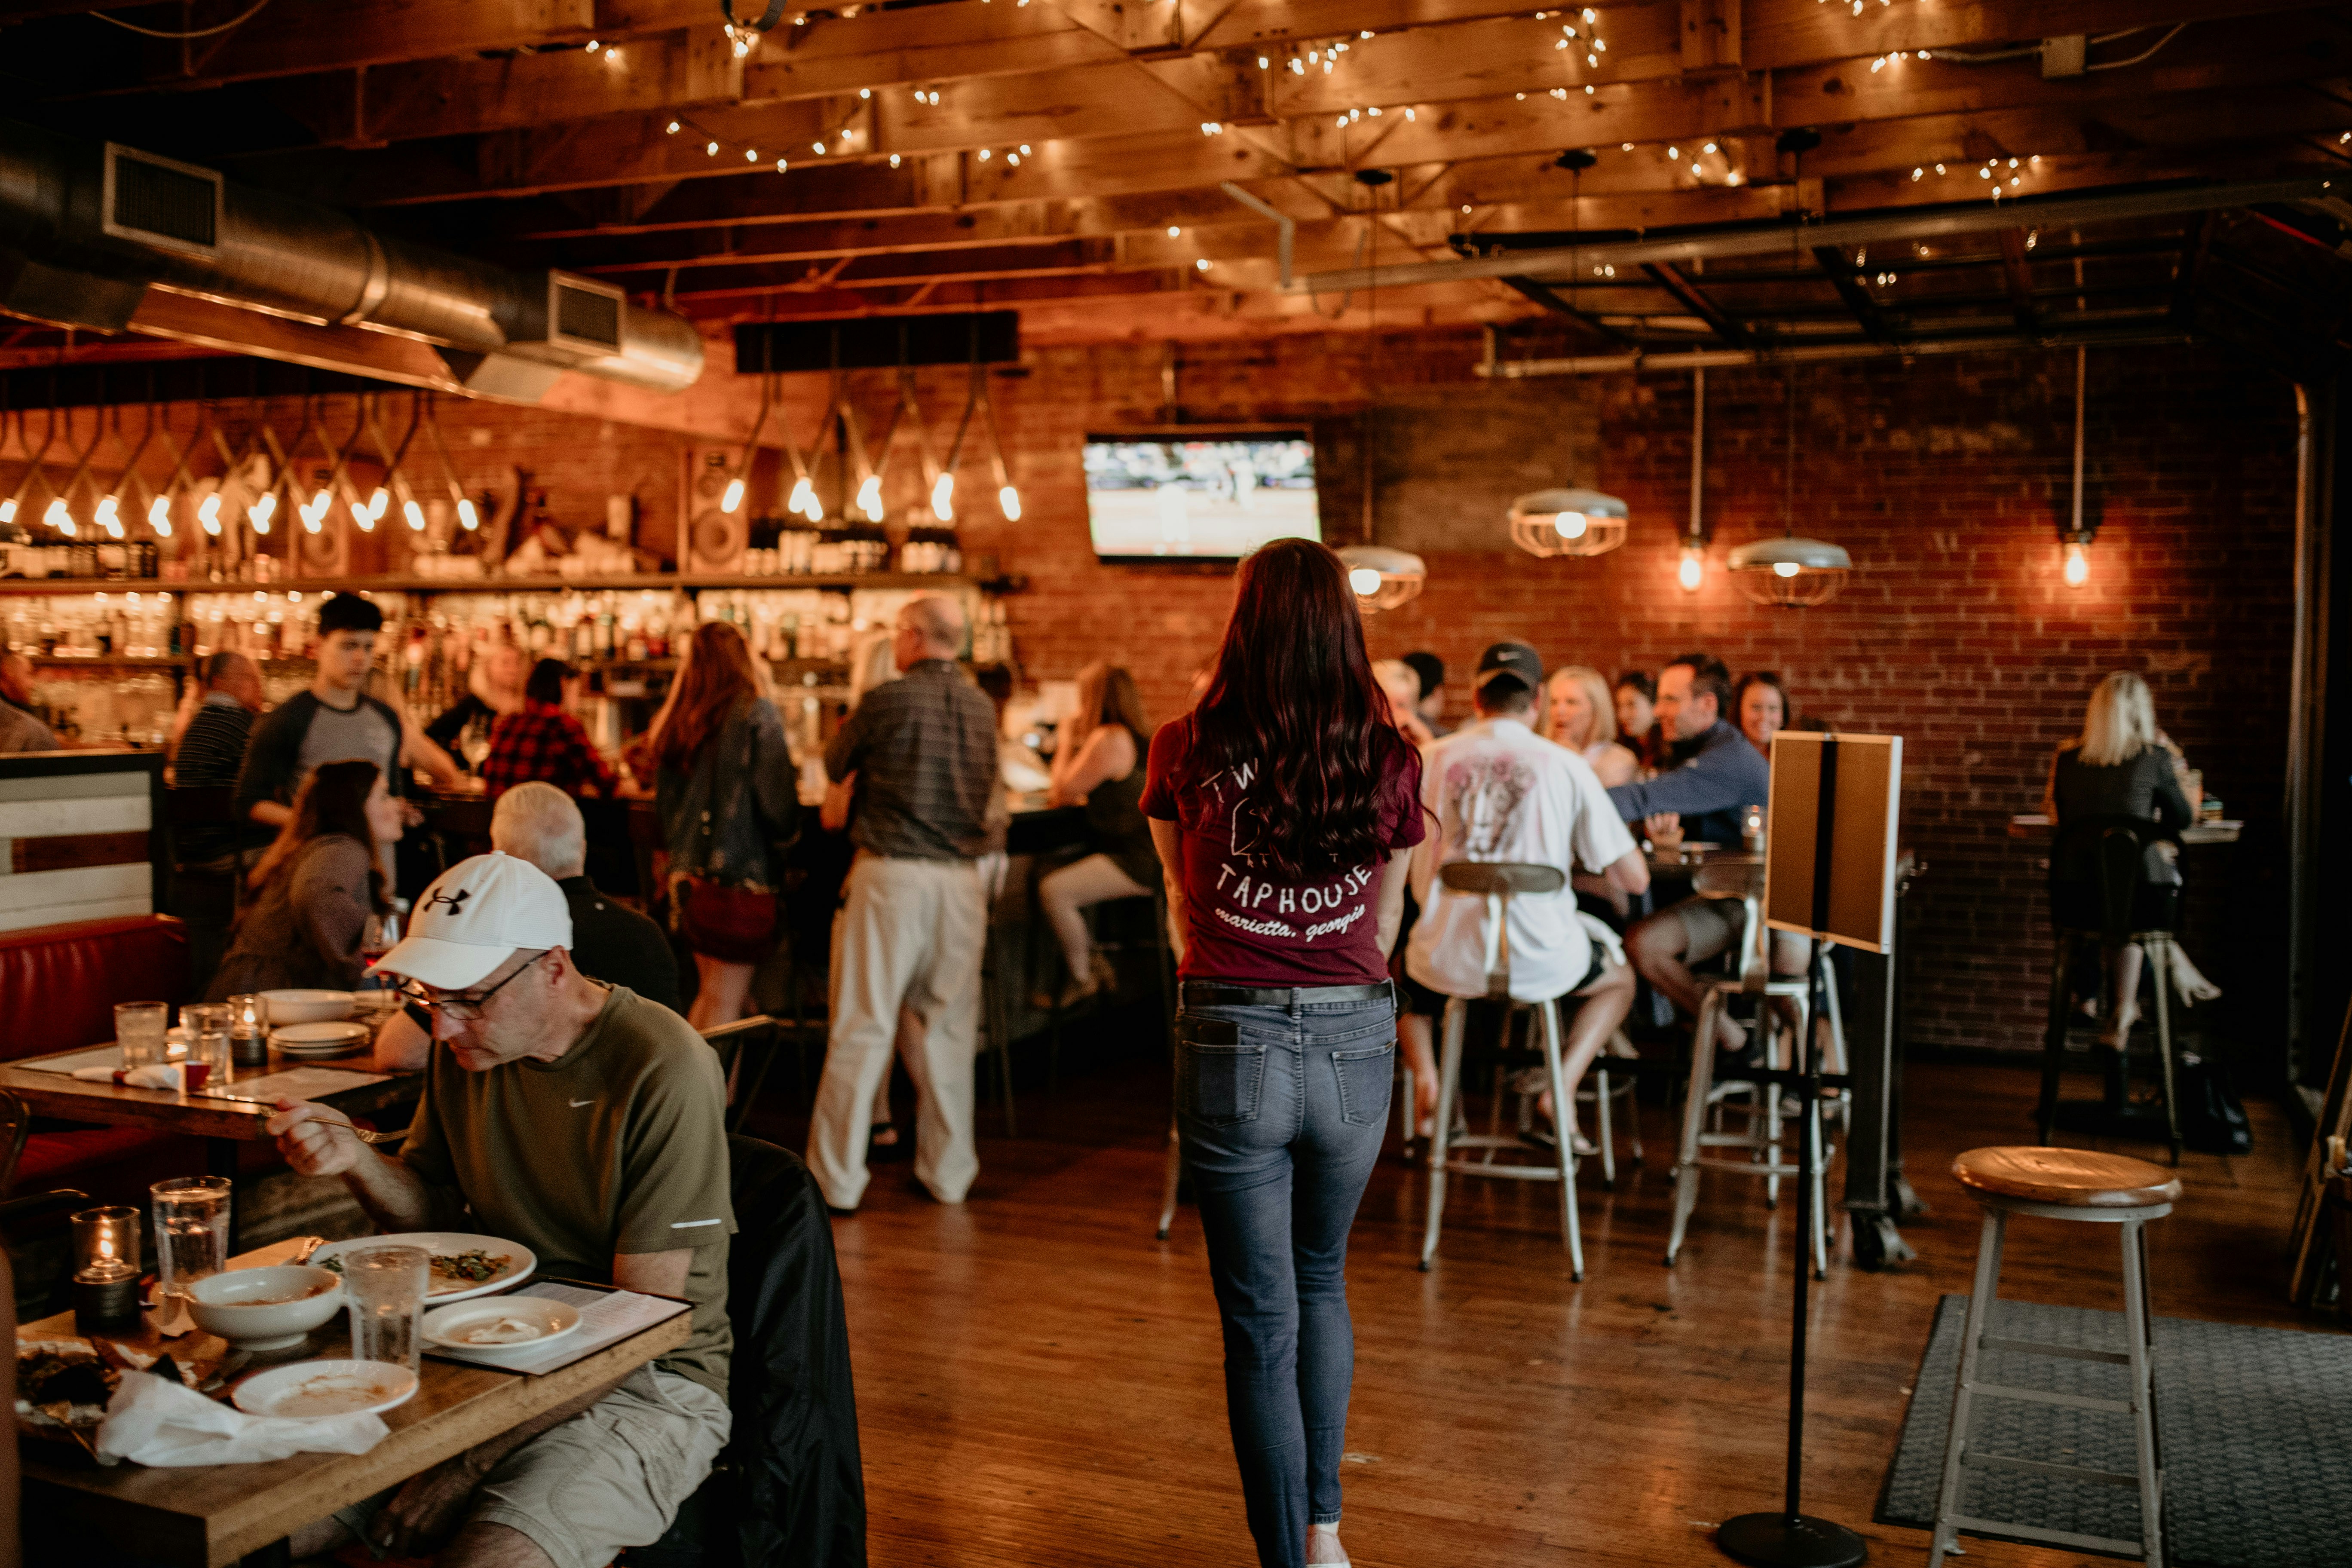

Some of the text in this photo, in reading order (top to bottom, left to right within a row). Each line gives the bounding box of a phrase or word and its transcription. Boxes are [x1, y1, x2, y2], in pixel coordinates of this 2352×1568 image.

[1200, 757, 1258, 803] TW
[1217, 863, 1372, 914] TAPHOUSE
[1305, 903, 1366, 943] georgia
